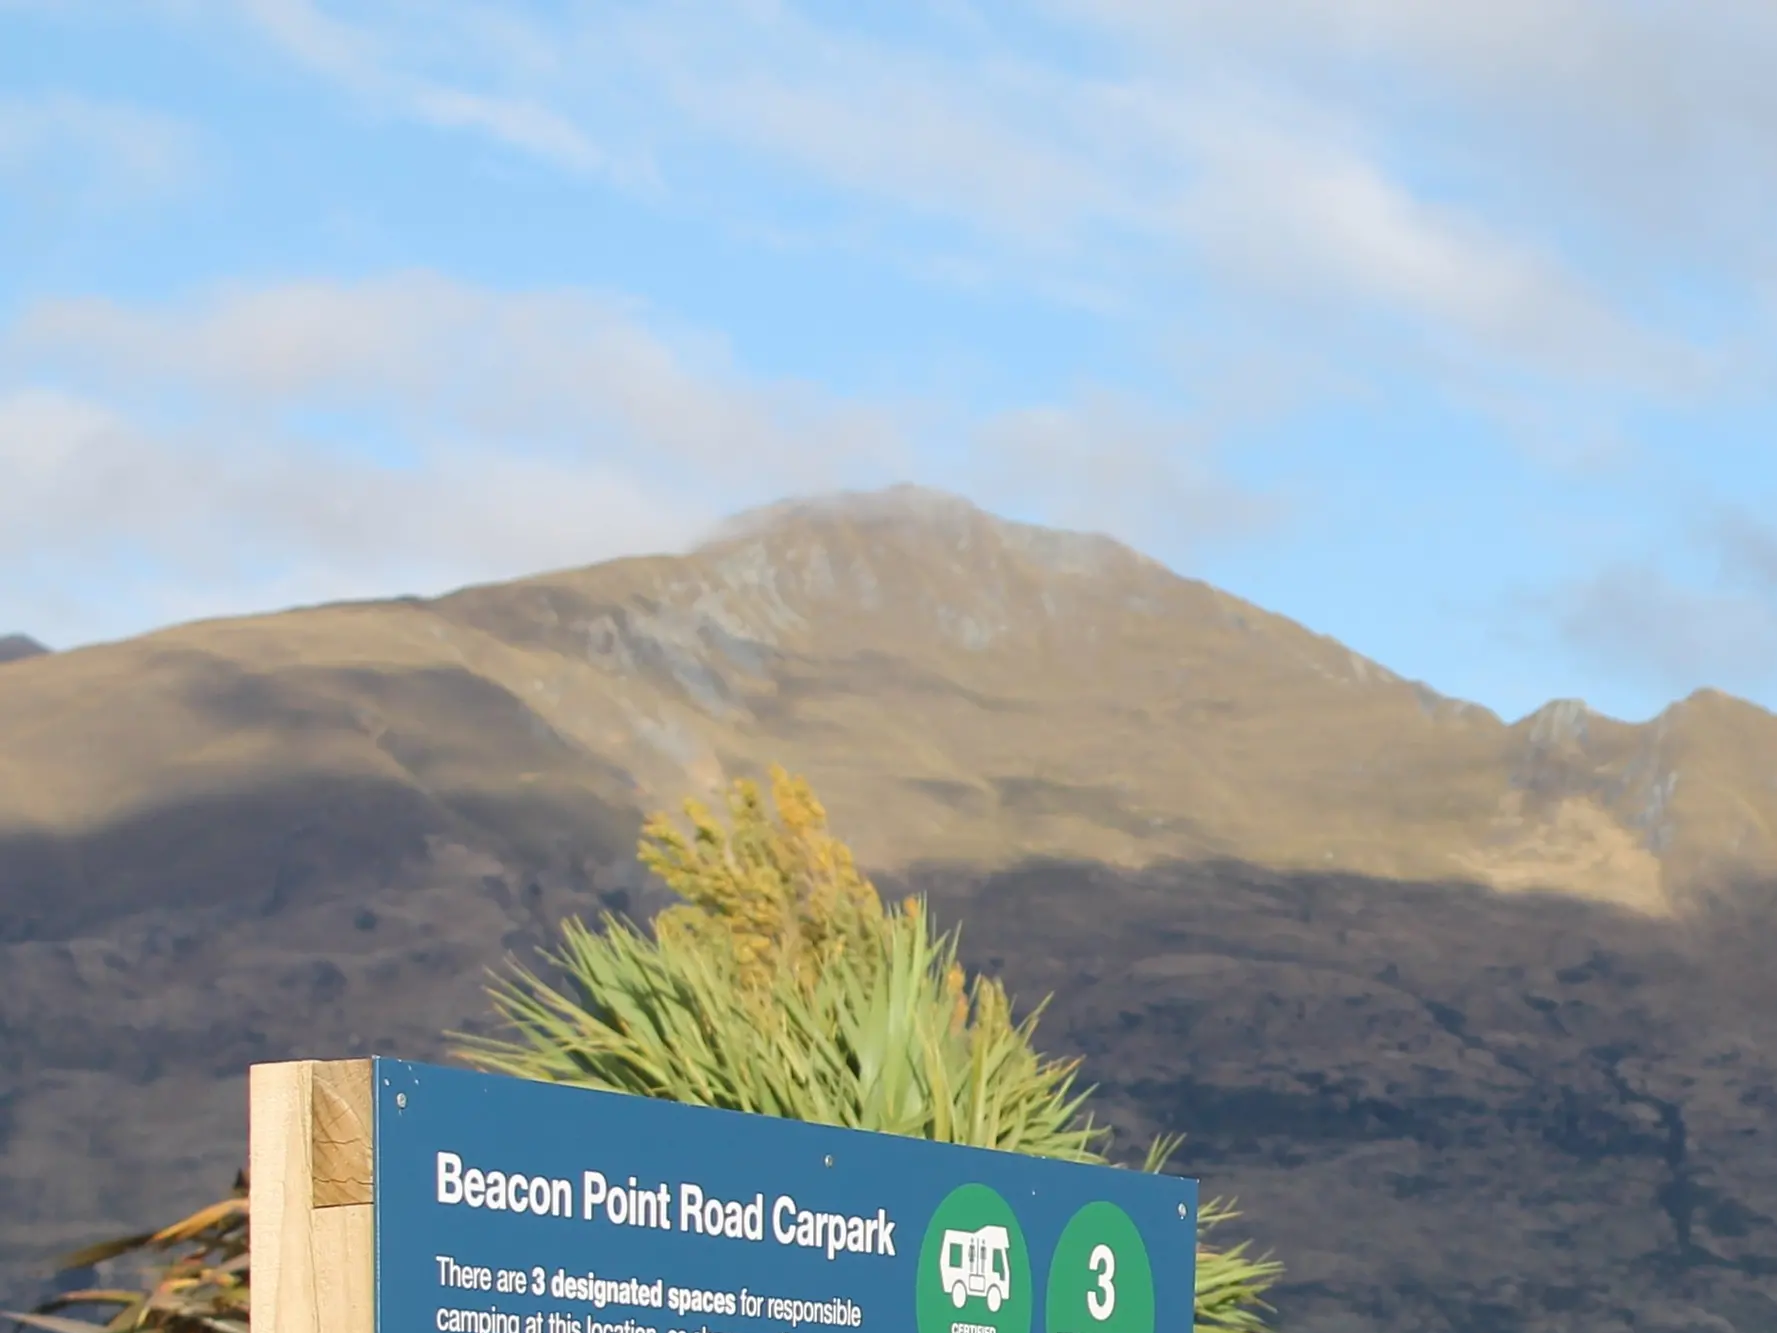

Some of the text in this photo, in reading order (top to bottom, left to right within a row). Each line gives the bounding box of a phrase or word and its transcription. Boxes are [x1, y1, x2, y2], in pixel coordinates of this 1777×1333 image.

[437, 1152, 895, 1258] Beacon Point Road Carpark
[436, 1256, 861, 1327] There are 3 designated spaces for responsible
[1087, 1244, 1115, 1320] 3
